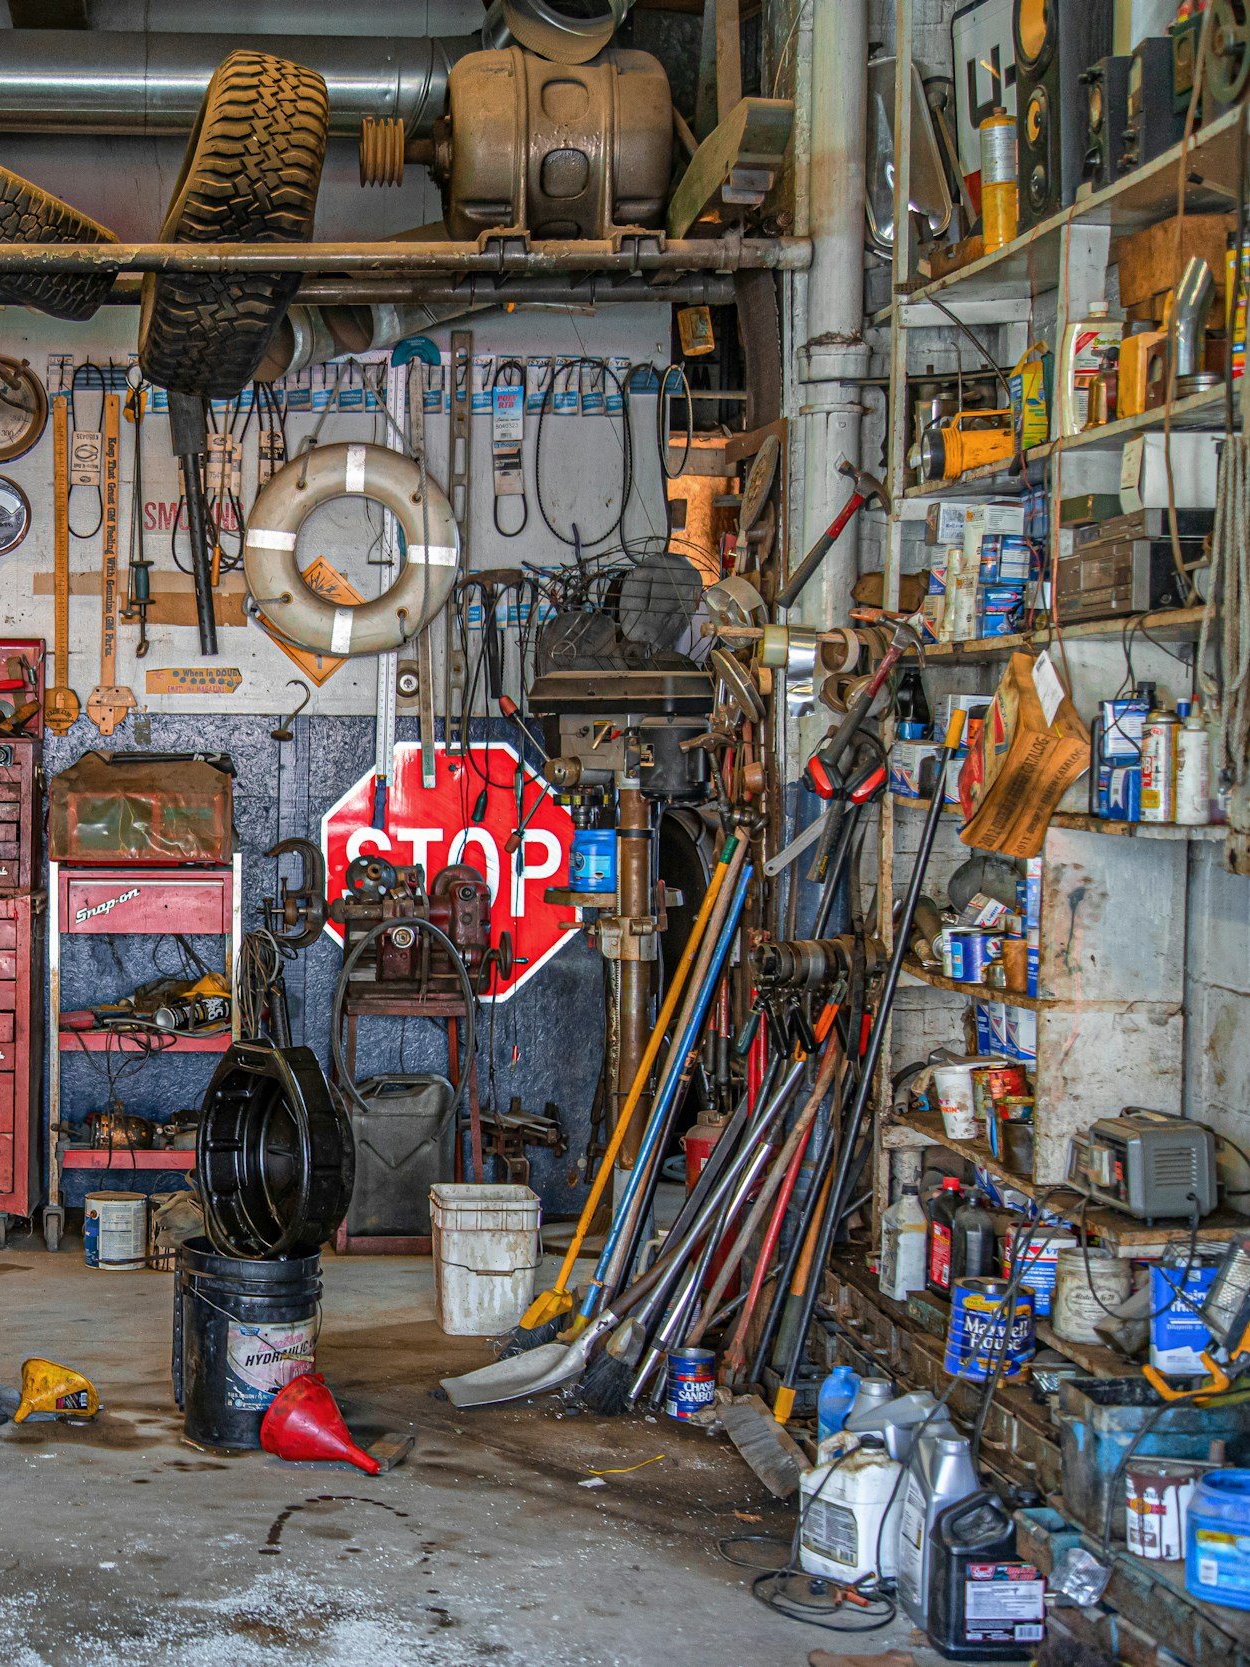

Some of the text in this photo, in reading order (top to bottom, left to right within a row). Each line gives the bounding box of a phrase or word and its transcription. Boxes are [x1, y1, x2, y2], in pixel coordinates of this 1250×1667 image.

[106, 437, 117, 457] Keep
[107, 460, 117, 479] That
[107, 483, 116, 505] Great
[107, 507, 116, 522] GM
[143, 501, 246, 531] SMOING
[104, 525, 116, 555] Feeling
[106, 558, 116, 577] With
[106, 580, 115, 613] Genuine
[105, 615, 115, 630] GM
[182, 669, 204, 678] When
[205, 669, 214, 677] in
[1022, 736, 1050, 776] CATALOG
[1055, 748, 1088, 781] CATALOG
[75, 888, 141, 924] Snap-on
[963, 1315, 1029, 1339] Maxwell
[969, 1332, 1022, 1351] House
[244, 1340, 310, 1367] HYDRAULIC
